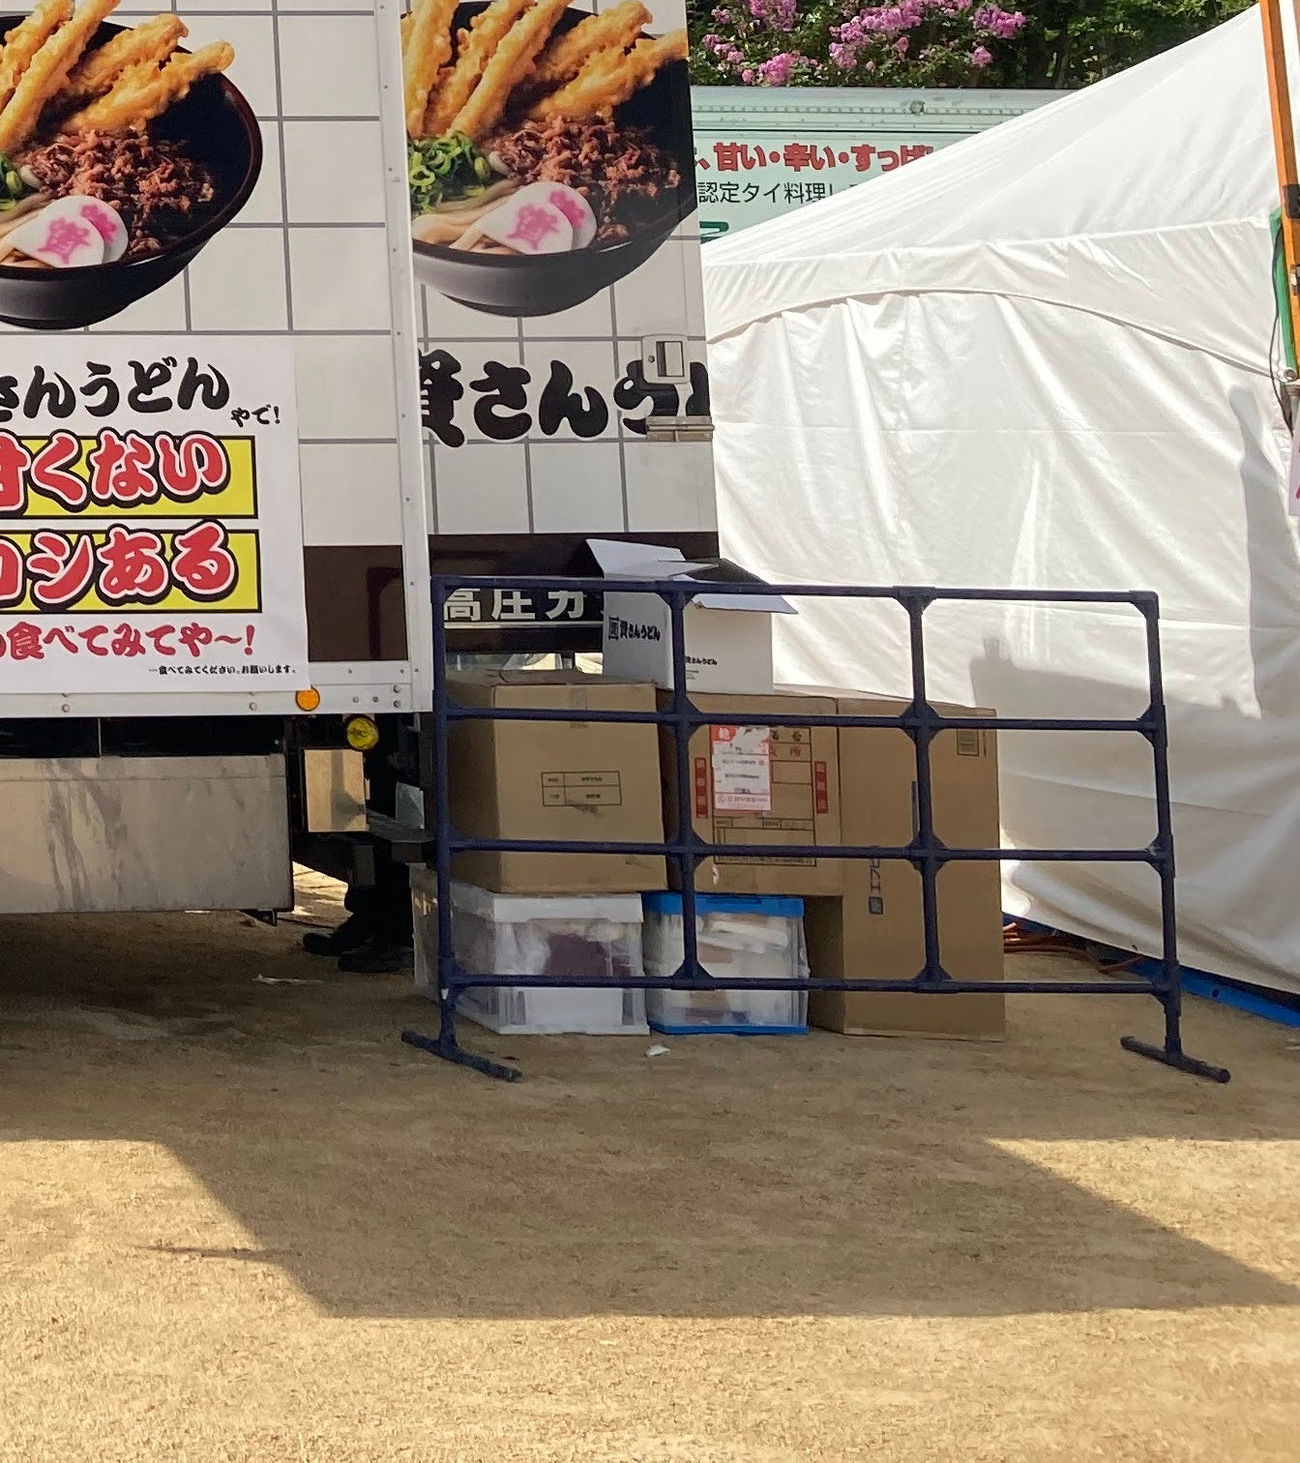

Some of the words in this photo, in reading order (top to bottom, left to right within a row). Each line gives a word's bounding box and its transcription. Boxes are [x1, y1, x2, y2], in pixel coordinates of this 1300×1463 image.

[229, 405, 281, 428] やで!
[619, 620, 661, 641] 資さんうどん
